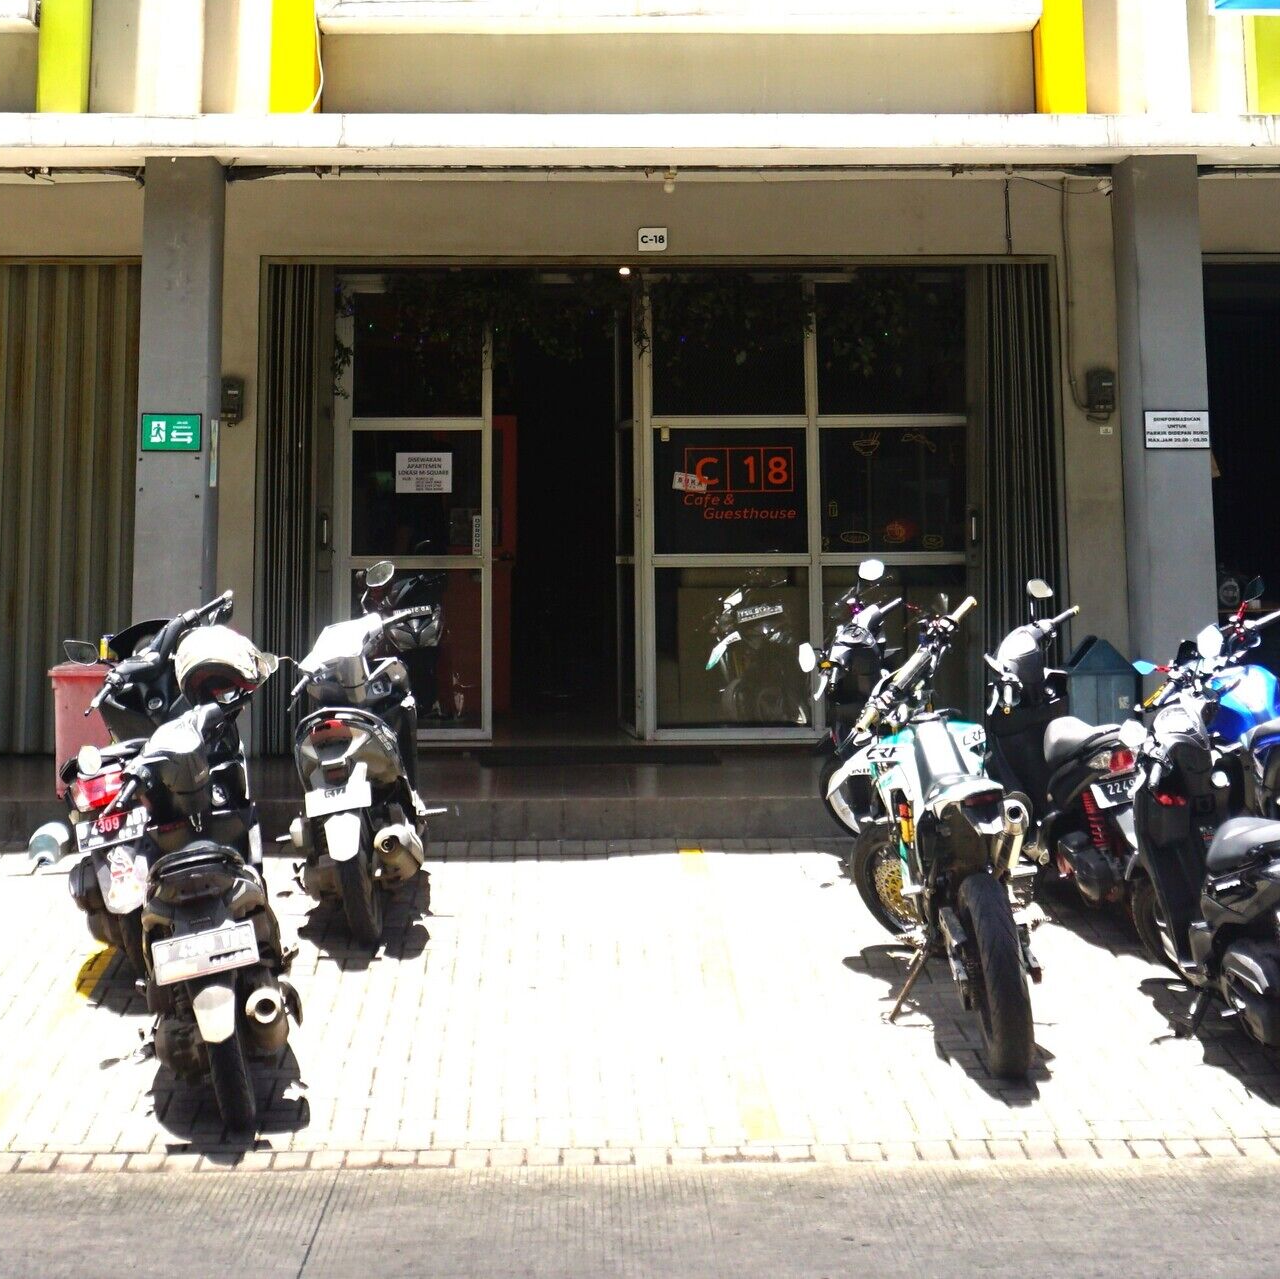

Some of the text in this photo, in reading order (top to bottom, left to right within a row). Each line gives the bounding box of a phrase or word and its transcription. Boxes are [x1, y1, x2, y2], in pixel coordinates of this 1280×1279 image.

[640, 234, 665, 244] C-18
[683, 494, 736, 507] Cafe &
[703, 507, 797, 520] Guesthouse
[962, 729, 985, 746] CRF
[866, 746, 904, 760] CRF
